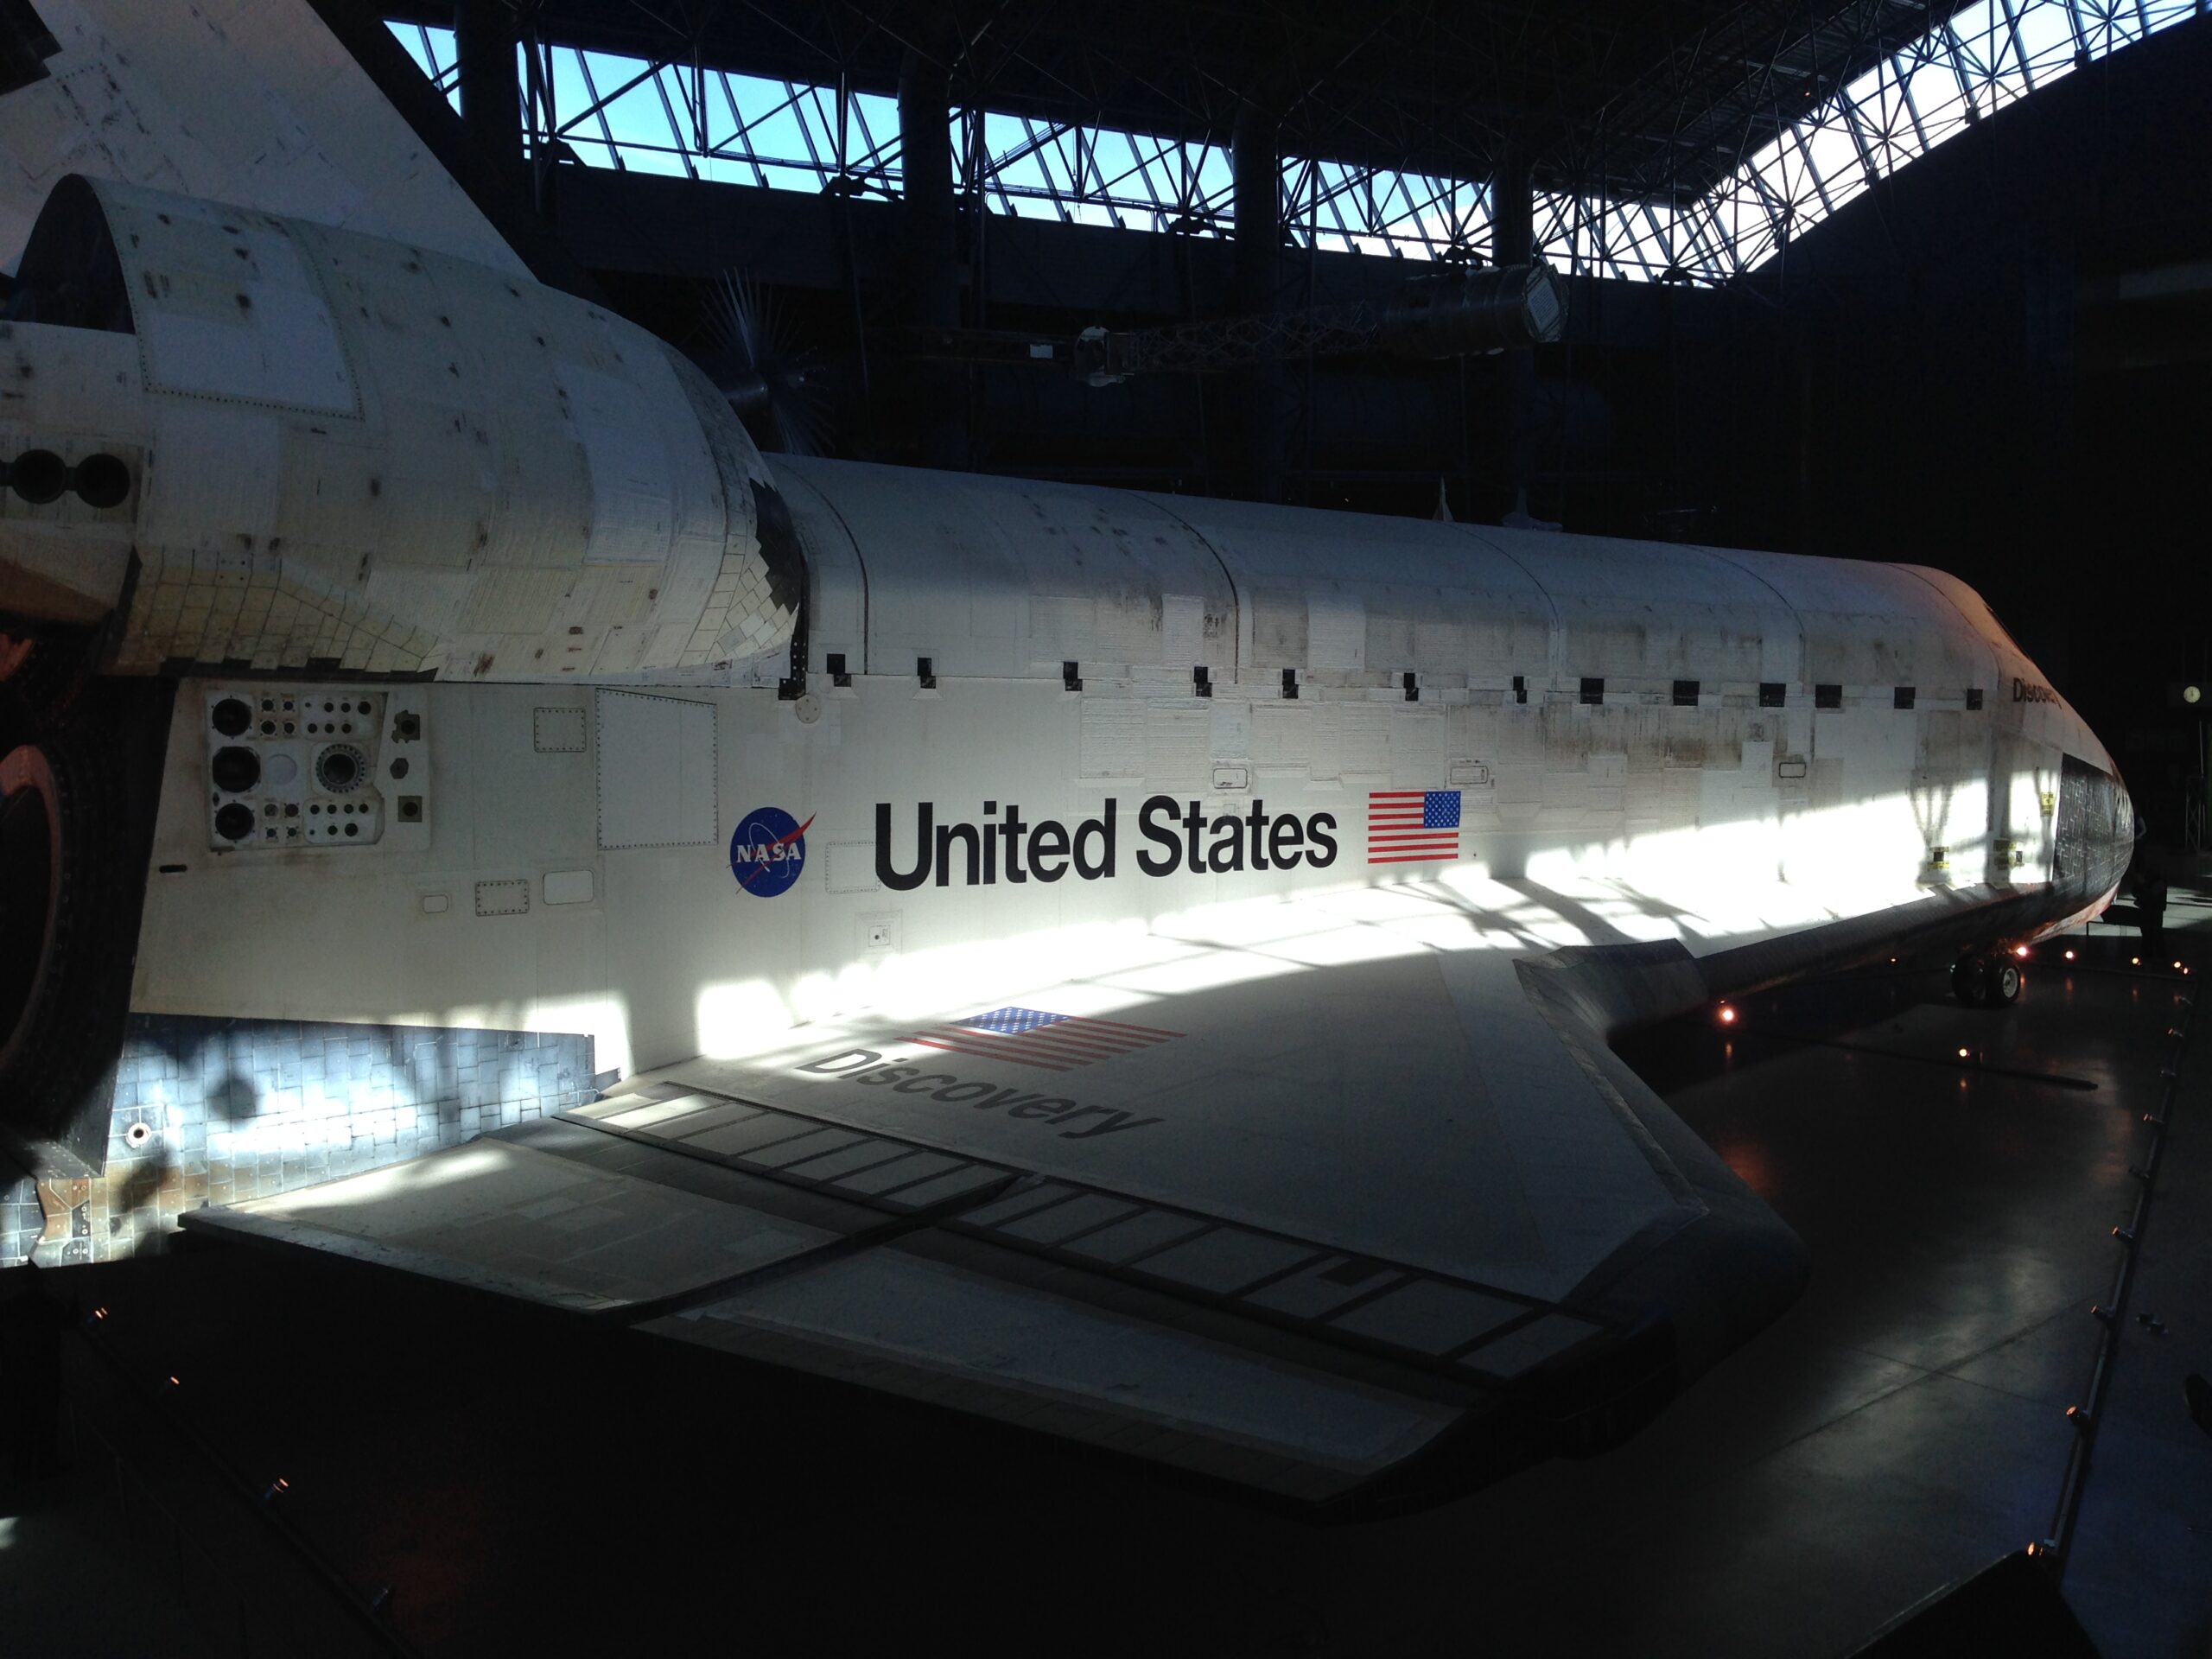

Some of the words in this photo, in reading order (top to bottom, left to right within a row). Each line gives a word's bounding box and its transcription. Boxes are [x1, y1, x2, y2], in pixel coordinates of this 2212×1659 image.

[736, 842, 801, 863] NASA
[875, 798, 1116, 891] United
[1136, 795, 1338, 877] States
[795, 1048, 1165, 1140] Discovery
